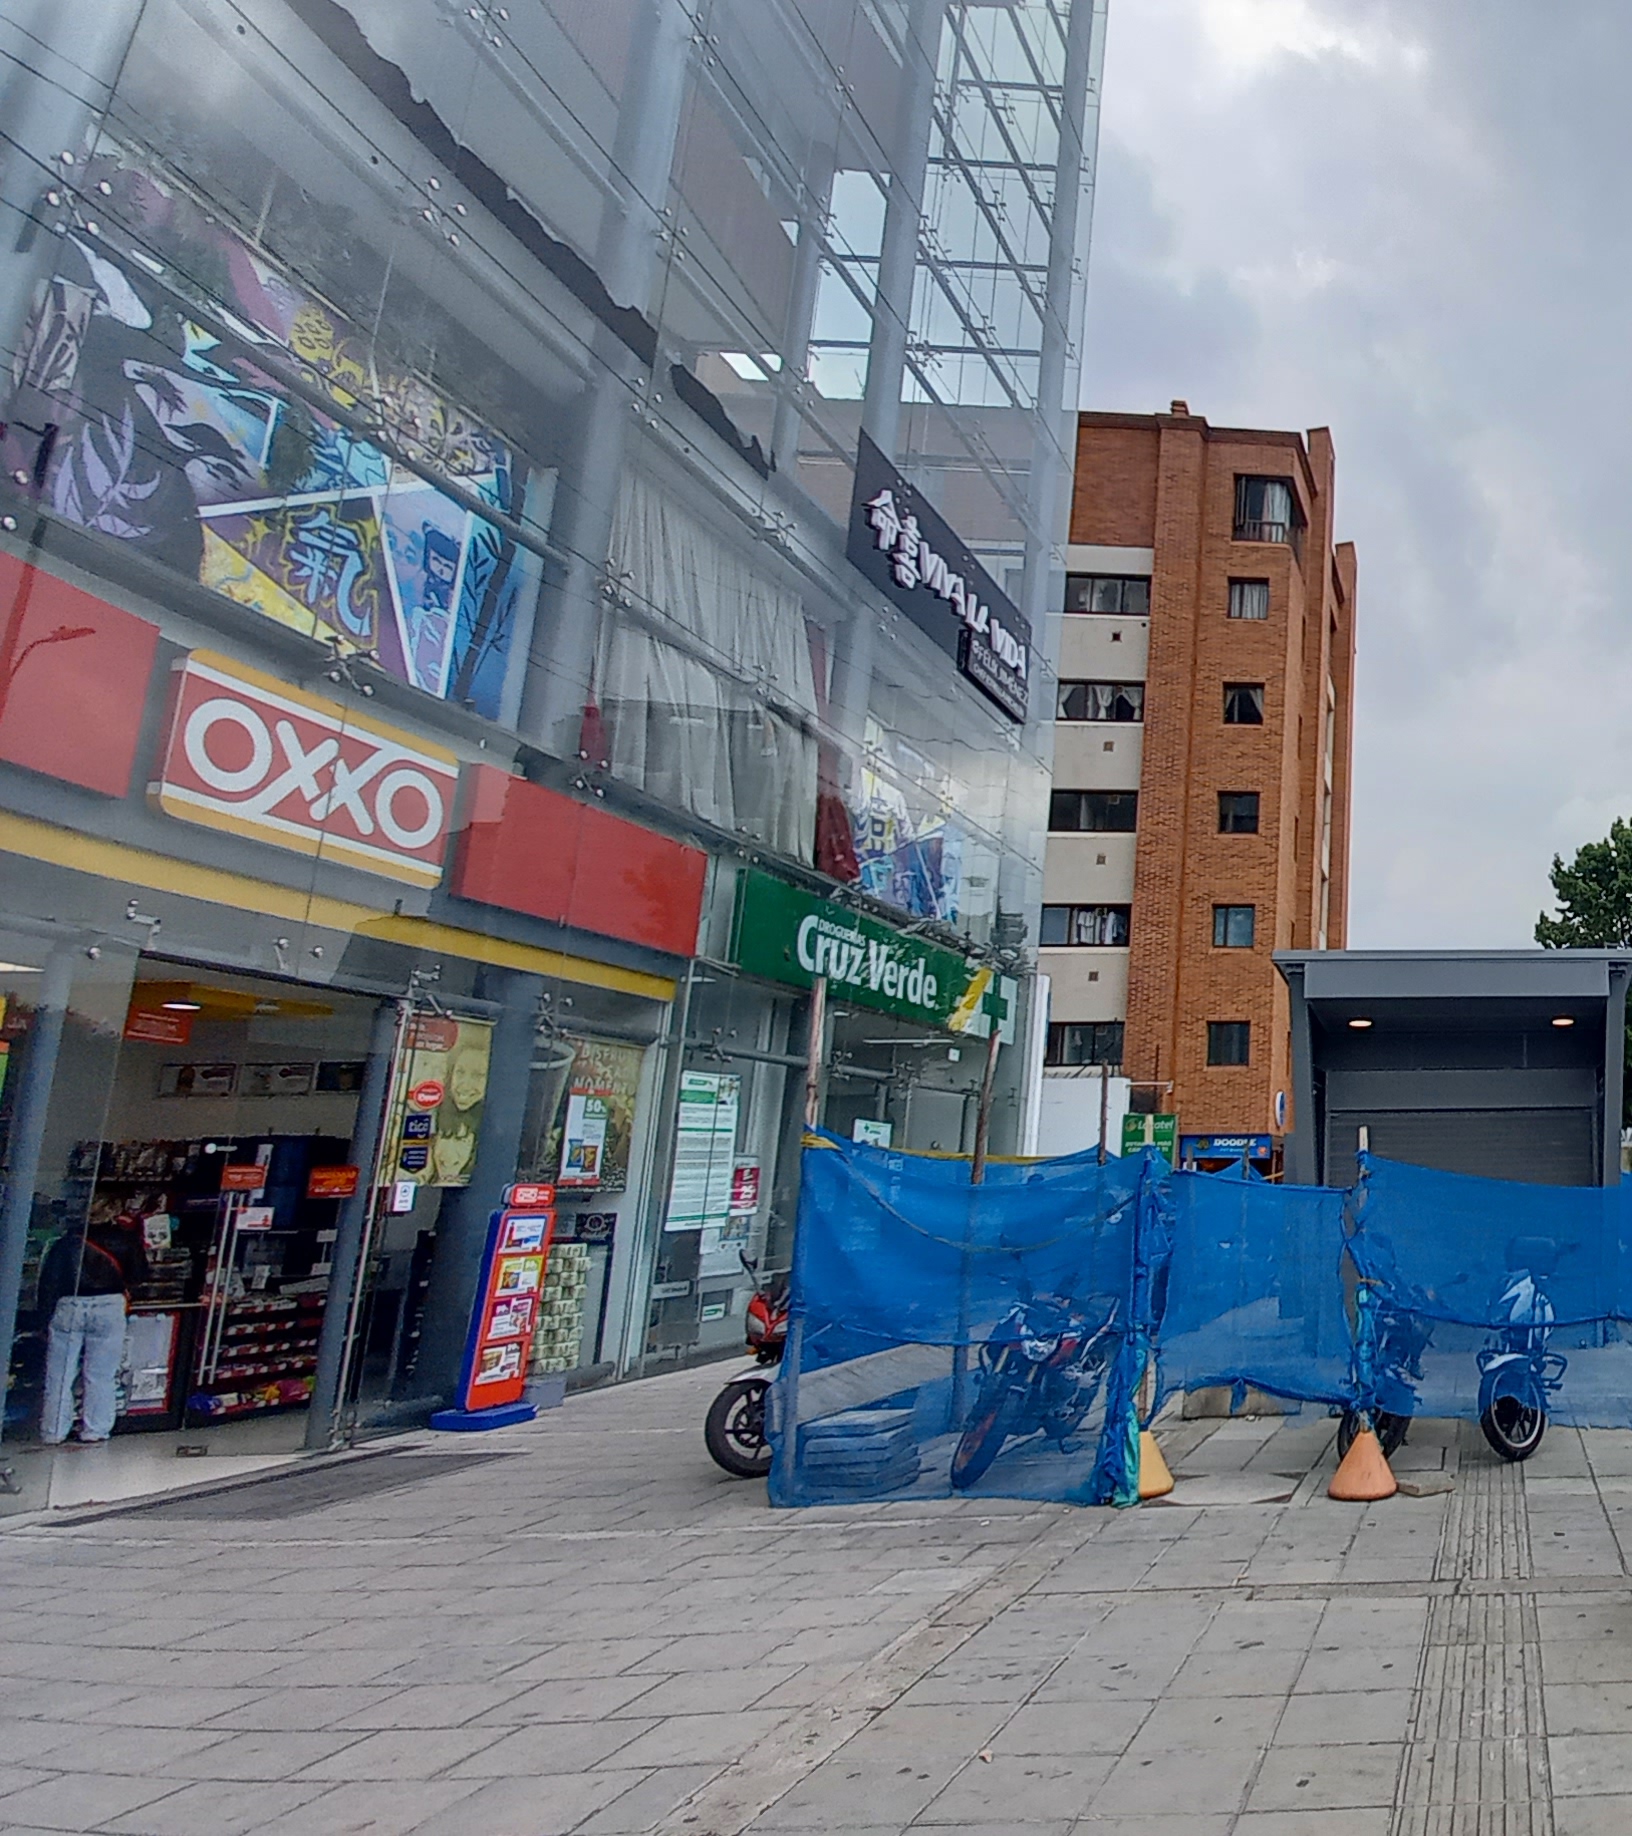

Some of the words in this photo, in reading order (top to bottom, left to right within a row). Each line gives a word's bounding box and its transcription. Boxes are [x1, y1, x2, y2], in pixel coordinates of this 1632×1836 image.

[918, 540, 966, 616] VIVA
[989, 617, 1027, 680] VIDA
[184, 696, 444, 850] OXXO
[797, 914, 866, 985] Cruz
[868, 938, 937, 1009] Verde
